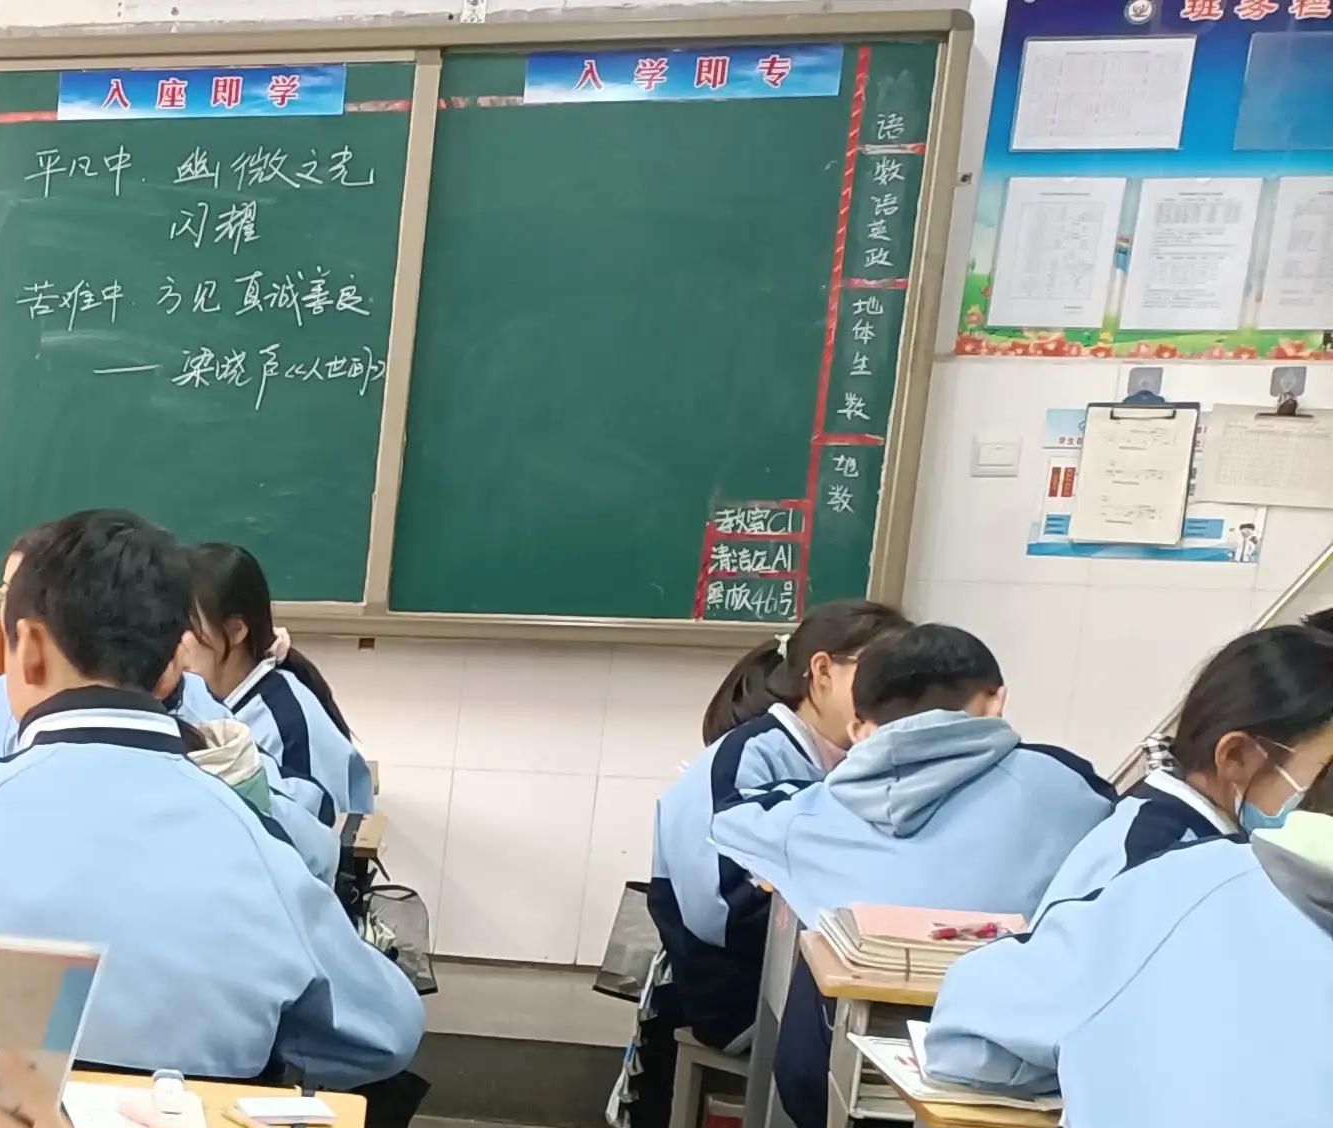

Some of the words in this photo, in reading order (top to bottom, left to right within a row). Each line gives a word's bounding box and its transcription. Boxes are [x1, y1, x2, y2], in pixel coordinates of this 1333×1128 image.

[575, 54, 794, 92] 入学即专
[102, 74, 301, 111] 入座即学
[169, 201, 261, 255] 闪耀
